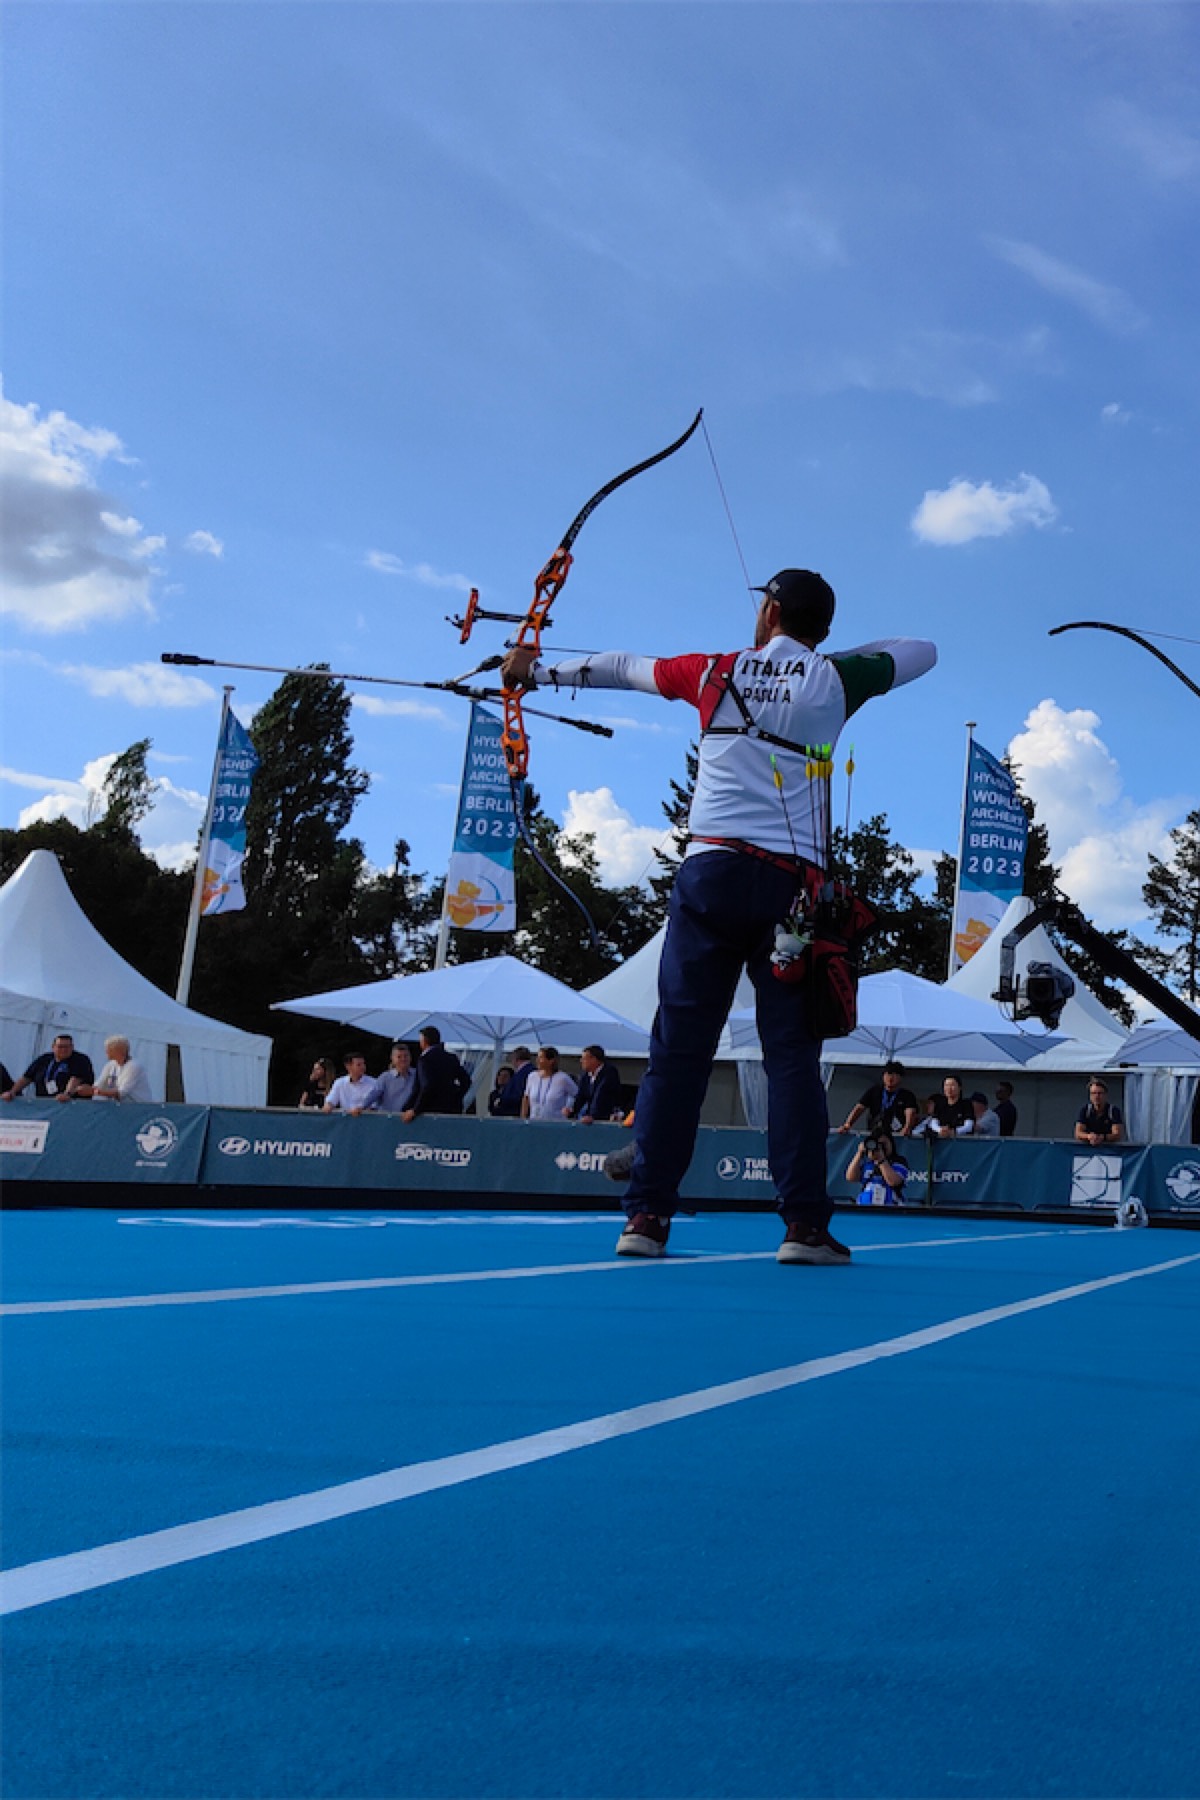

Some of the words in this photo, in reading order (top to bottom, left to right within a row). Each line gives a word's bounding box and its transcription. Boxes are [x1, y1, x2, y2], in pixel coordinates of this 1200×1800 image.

[741, 658, 805, 678] ITALIA
[473, 735, 502, 749] HYU
[472, 753, 507, 768] WOR
[470, 771, 509, 785] ARCHE
[461, 817, 517, 839] 2023
[969, 833, 1023, 853] BERLIN
[967, 855, 1021, 877] 2023
[253, 1140, 332, 1158] HYUNDAI
[579, 1152, 607, 1172] err
[744, 1158, 769, 1169] TUR
[742, 1169, 773, 1181] AIRL
